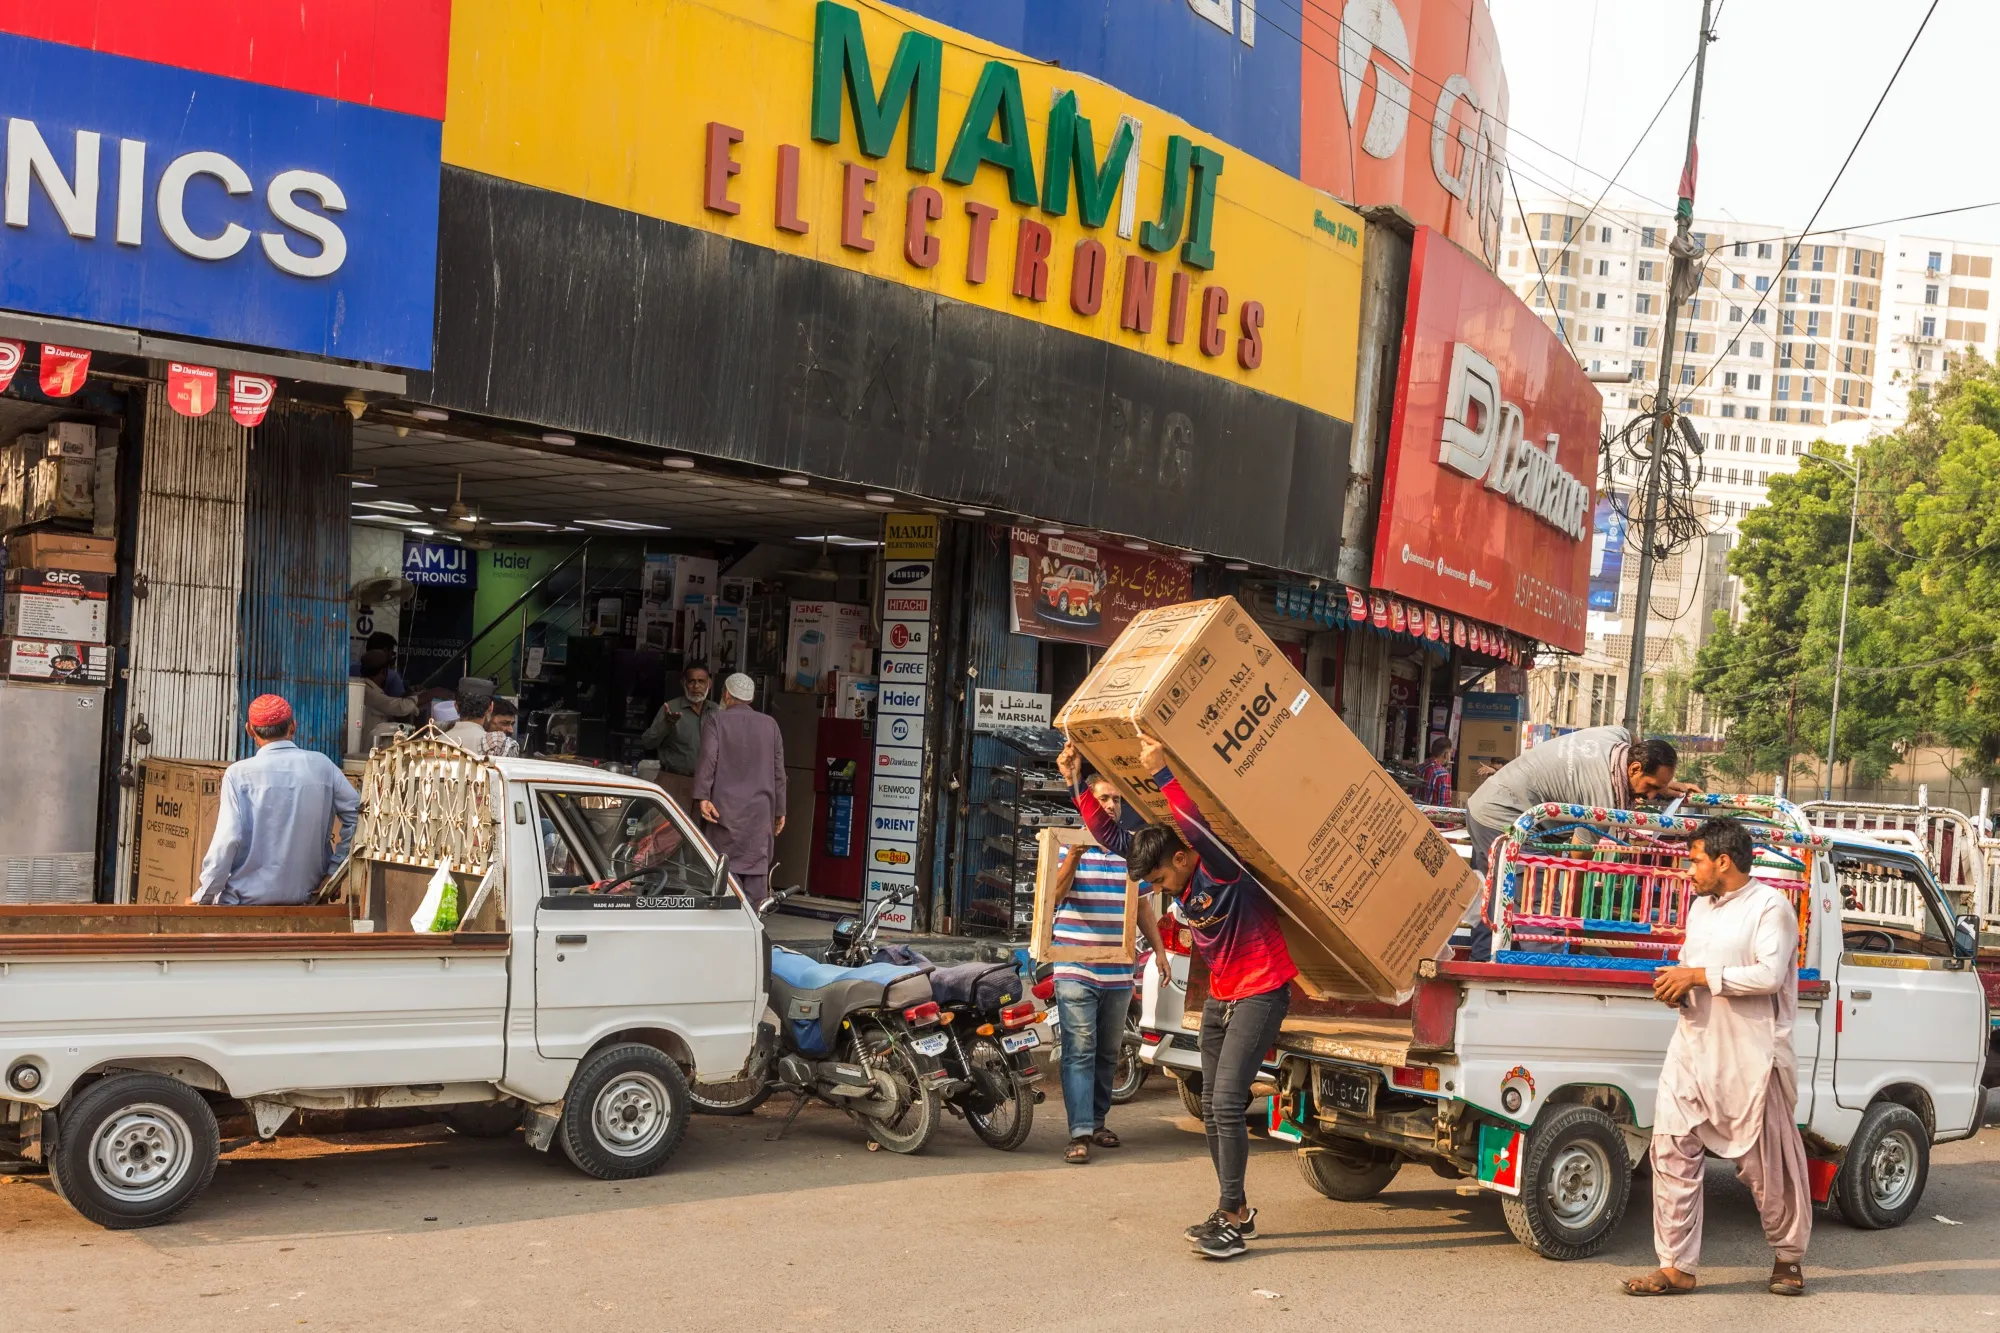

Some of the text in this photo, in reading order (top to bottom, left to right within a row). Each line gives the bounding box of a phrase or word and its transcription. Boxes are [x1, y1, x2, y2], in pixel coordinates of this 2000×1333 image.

[811, 1, 1224, 271] MAMJI
[5, 117, 348, 278] NICS
[704, 121, 1265, 370] ELECTRONICS
[55, 348, 88, 360] Dawlance
[182, 367, 214, 377] Dawlance
[1483, 401, 1589, 542] Dawlance
[889, 525, 934, 539] MAMJI
[1011, 527, 1039, 545] Haier
[887, 541, 934, 549] ELECTRONICS
[402, 547, 467, 570] AMJI
[493, 551, 531, 570] Haier
[893, 570, 925, 578] SAMSUNG
[796, 604, 823, 613] GNE
[840, 608, 864, 617] GNE
[890, 600, 926, 611] HITACHI
[909, 632, 921, 643] LG
[894, 662, 924, 674] GREE
[1229, 662, 1251, 688] No.1
[883, 690, 921, 707] Haier
[1100, 700, 1127, 712] STEP
[1205, 671, 1256, 736] REFRIGERATOR BRAND
[1475, 703, 1511, 711] EcoStar
[997, 712, 1047, 723] MARSHAL
[1212, 682, 1278, 764] Haier
[893, 726, 907, 734] PEL
[1233, 707, 1291, 778] Inspired Living
[889, 757, 918, 767] Dawlance
[878, 784, 915, 795] KENWOOD
[155, 794, 183, 818] Haier
[875, 816, 915, 832] ORIENT
[1312, 788, 1355, 847] HANDLE WITH CARE
[146, 820, 190, 838] CHEST FREEZER
[889, 852, 907, 864] asia
[636, 896, 695, 908] SUZUKI
[1414, 914, 1429, 933] Haier
[1415, 930, 1429, 948] HNR
[1427, 898, 1452, 931] Company
